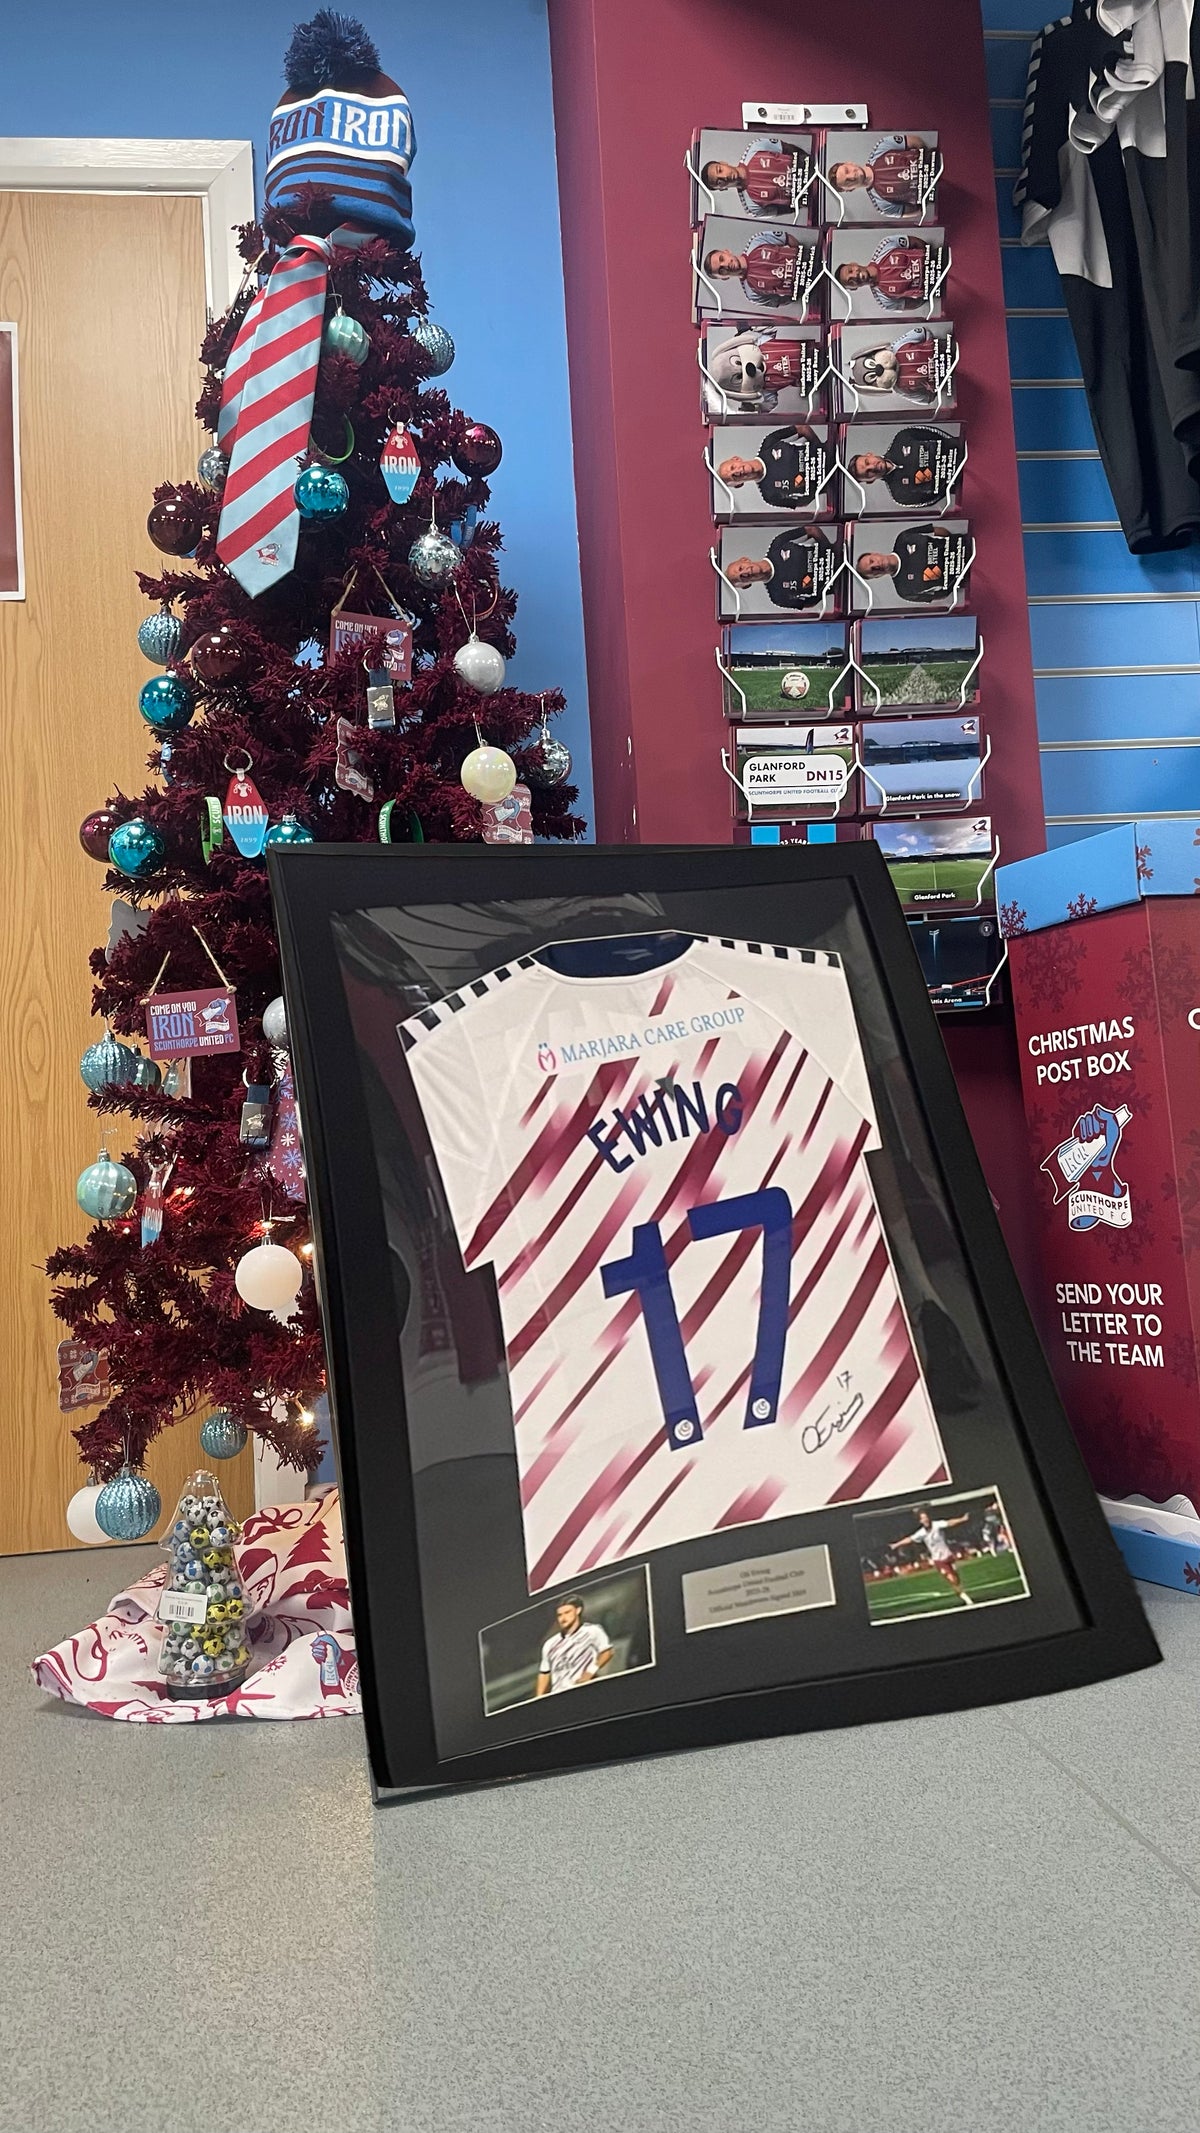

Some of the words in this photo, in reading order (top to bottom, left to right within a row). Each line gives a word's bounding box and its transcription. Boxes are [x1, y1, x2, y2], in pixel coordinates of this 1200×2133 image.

[267, 101, 327, 158] RON
[330, 102, 411, 155] IRON
[384, 455, 416, 475] IRON
[335, 619, 354, 631] COME
[354, 622, 363, 633] ON
[749, 762, 806, 772] GLANFORD
[749, 774, 776, 783] PARK
[806, 770, 843, 782] DN15
[885, 794, 911, 802] Glanford
[912, 792, 926, 801] Park
[227, 805, 264, 825] IRON
[914, 893, 941, 901] Glanford
[941, 892, 956, 900] Park
[150, 1003, 171, 1016] COME
[170, 1002, 181, 1014] ON
[181, 1001, 197, 1013] YOU
[151, 1012, 196, 1040] IRON
[561, 1033, 646, 1064] MARJARA
[643, 1021, 690, 1046] CARE
[690, 1007, 745, 1034] GROUP
[1027, 1015, 1136, 1057] CHRISTMAS
[153, 1037, 199, 1052] SCUNTHORPE
[198, 1034, 225, 1047] UNITED
[225, 1034, 235, 1044] FC
[1036, 1058, 1083, 1086] POST
[1086, 1049, 1133, 1078] BOX
[588, 1081, 743, 1173] EWING
[1070, 1193, 1129, 1211] SCUNTHORPE
[1071, 1204, 1105, 1218] UNITED
[1055, 1282, 1103, 1305] SEND
[1105, 1283, 1165, 1306] YOUR
[600, 1186, 793, 1451] 17
[1062, 1311, 1129, 1336] LETTER
[1131, 1313, 1162, 1337] TO
[1066, 1340, 1103, 1364] THE
[1104, 1342, 1165, 1368] TEAM
[836, 1370, 854, 1392] 17
